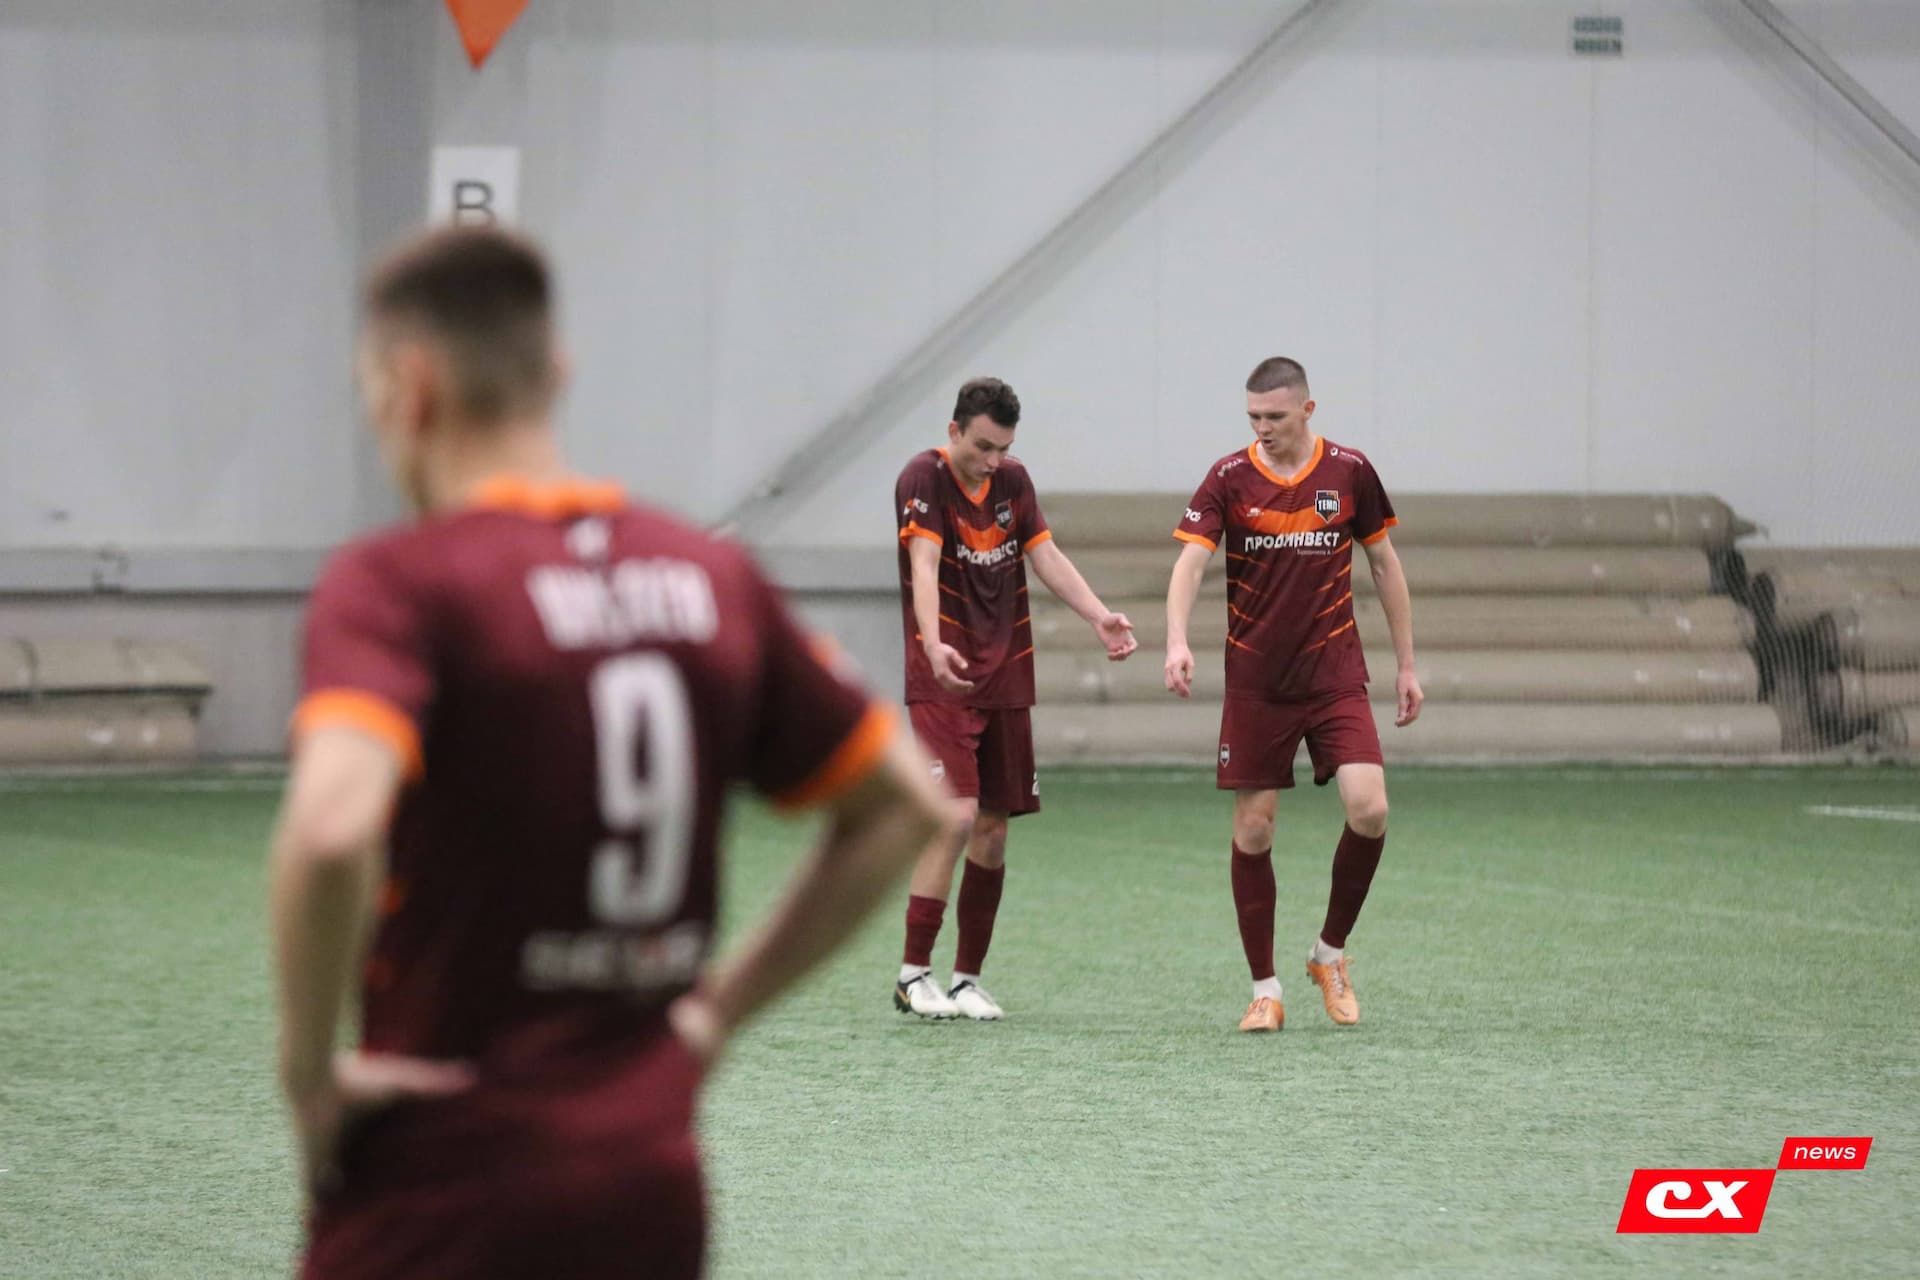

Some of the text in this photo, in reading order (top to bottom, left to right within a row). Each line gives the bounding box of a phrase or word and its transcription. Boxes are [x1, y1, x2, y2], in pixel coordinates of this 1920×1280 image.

[1318, 499, 1338, 512] ТЕМП
[1245, 532, 1340, 552] ПРОДИНВЕСТ
[590, 652, 696, 926] 9
